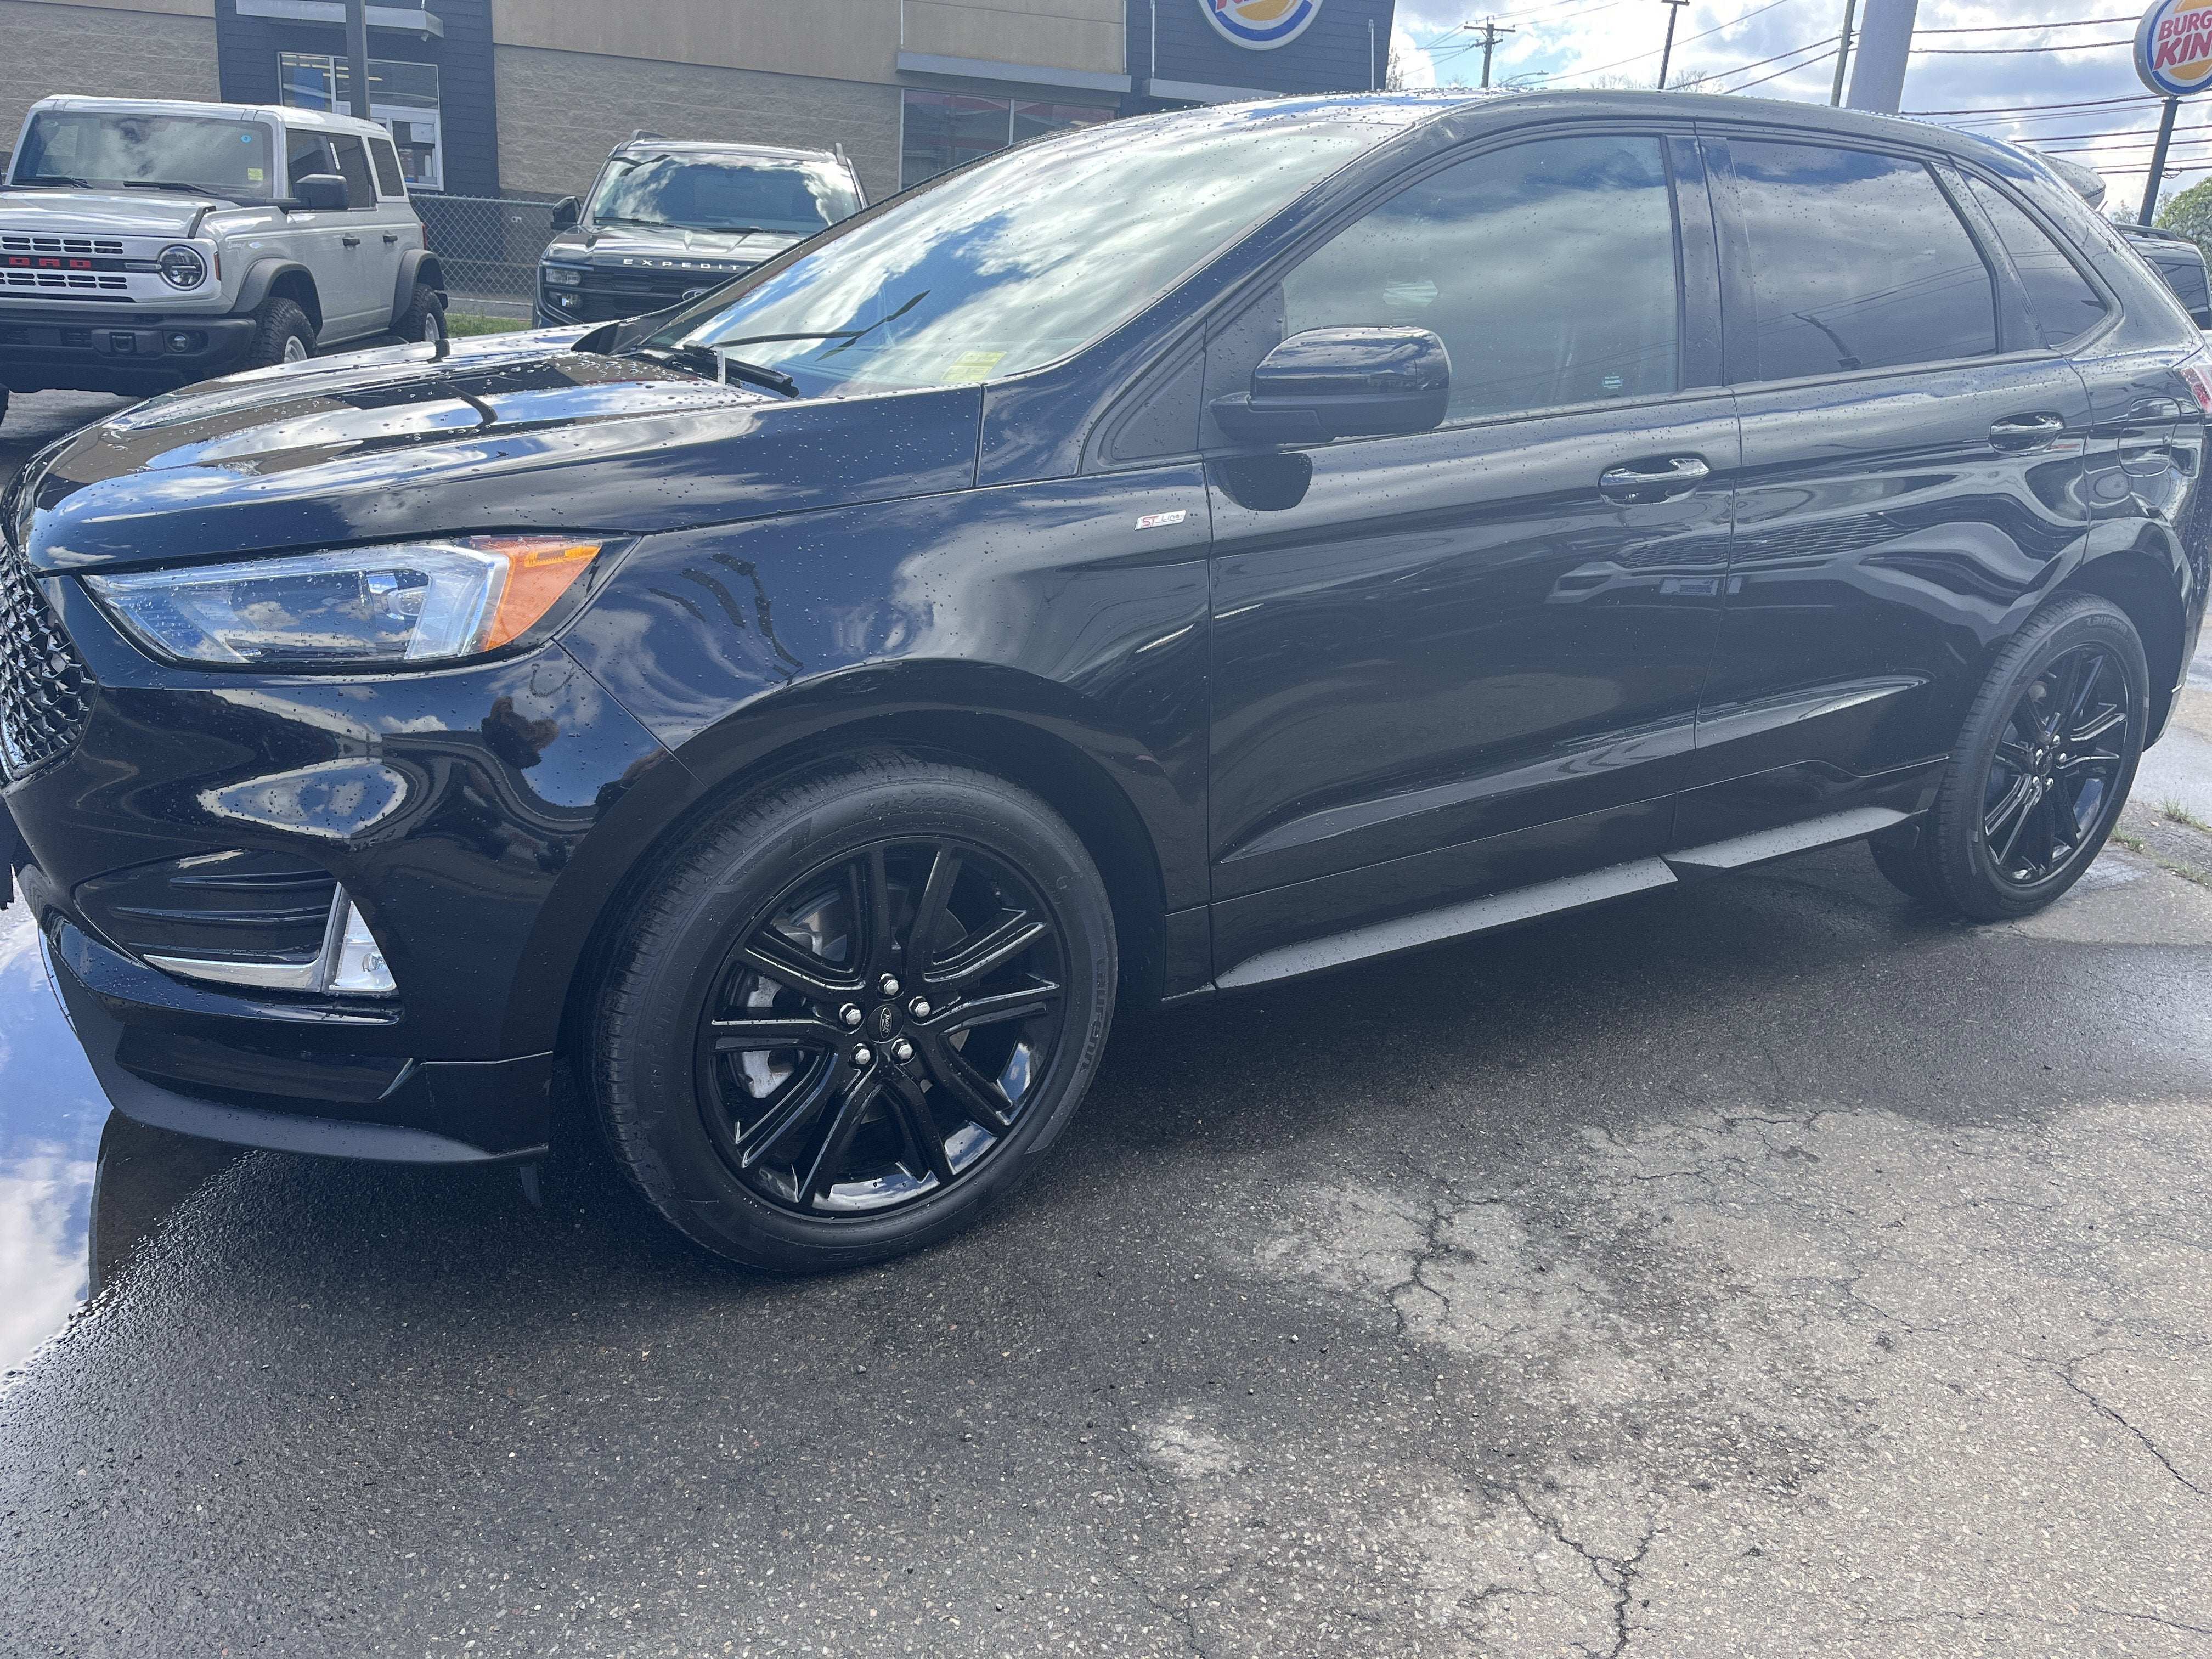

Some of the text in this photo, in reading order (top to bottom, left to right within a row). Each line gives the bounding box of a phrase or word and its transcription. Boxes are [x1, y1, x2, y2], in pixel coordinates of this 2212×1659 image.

[2153, 30, 2212, 70] KIN
[1142, 515, 1159, 527] ST
[882, 1013, 890, 1032] Ford
